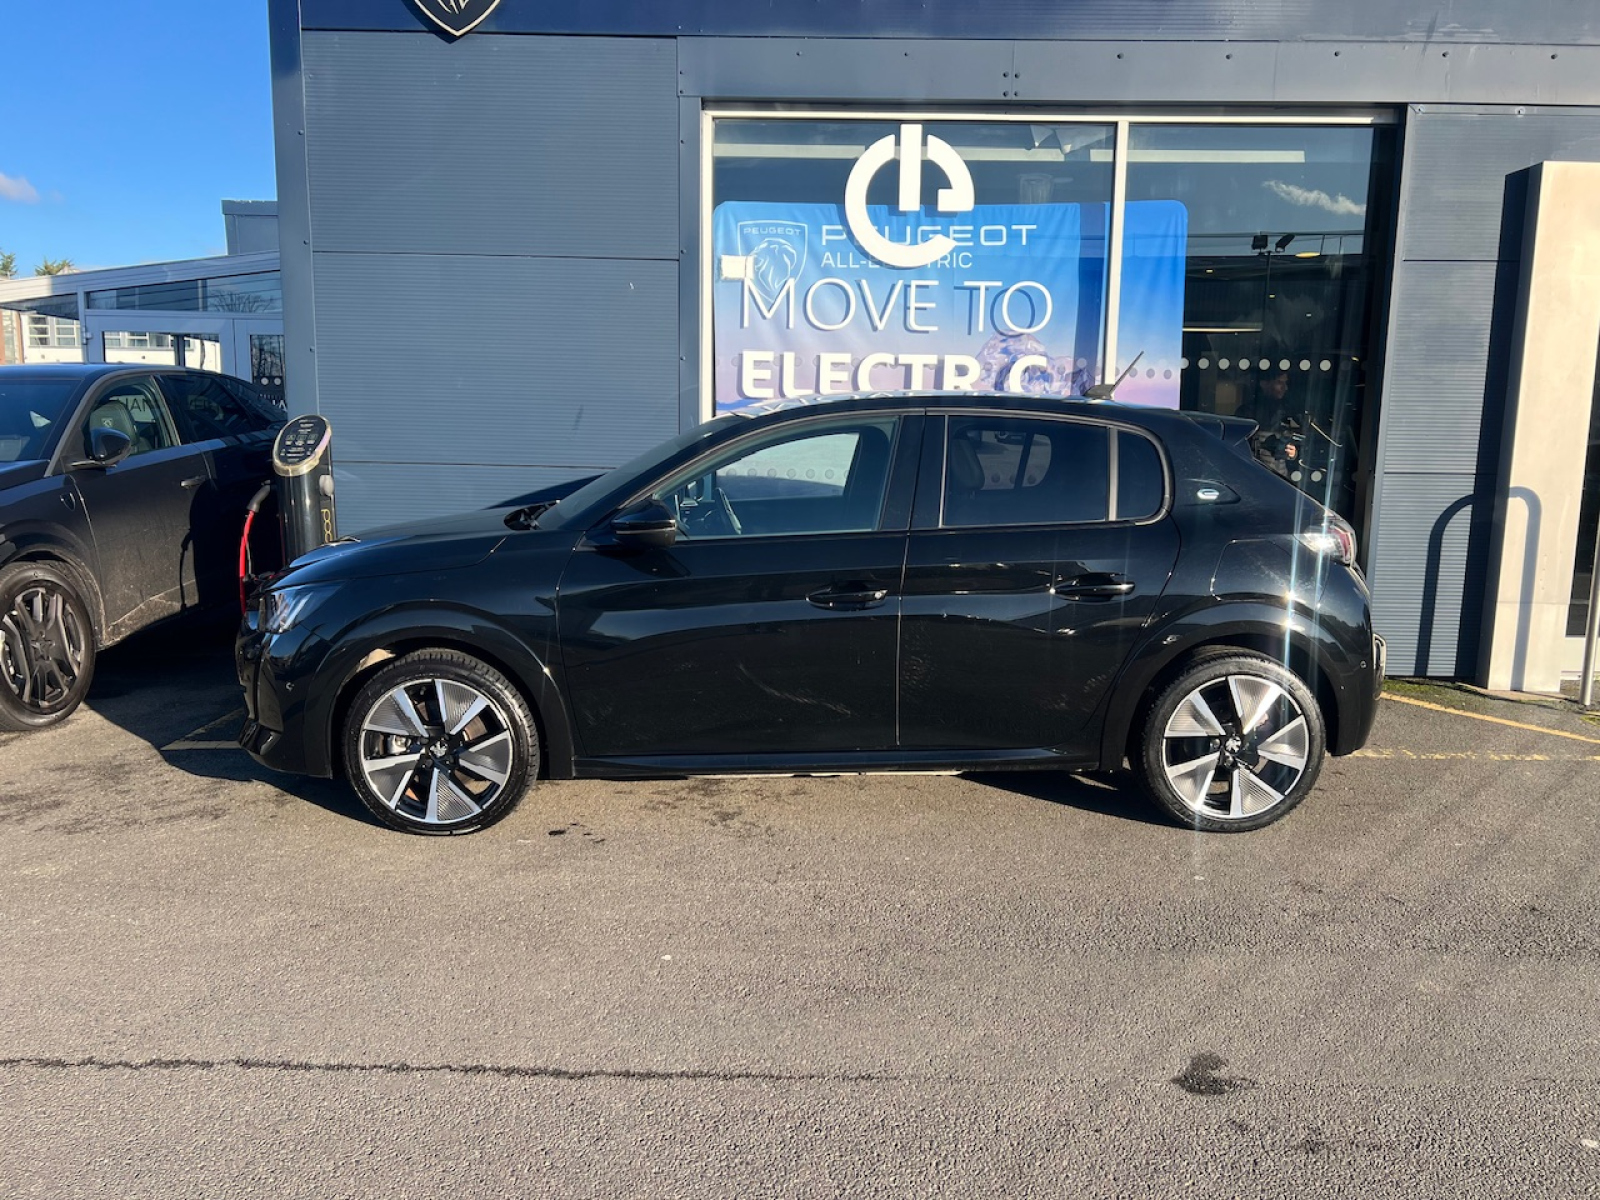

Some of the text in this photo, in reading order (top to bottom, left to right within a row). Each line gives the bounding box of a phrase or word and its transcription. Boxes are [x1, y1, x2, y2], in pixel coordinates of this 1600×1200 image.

[743, 226, 801, 236] PEUGEOT
[821, 224, 1037, 247] PUGEOT
[743, 277, 1053, 334] MOVE TO
[741, 350, 1047, 399] ELECTRC
